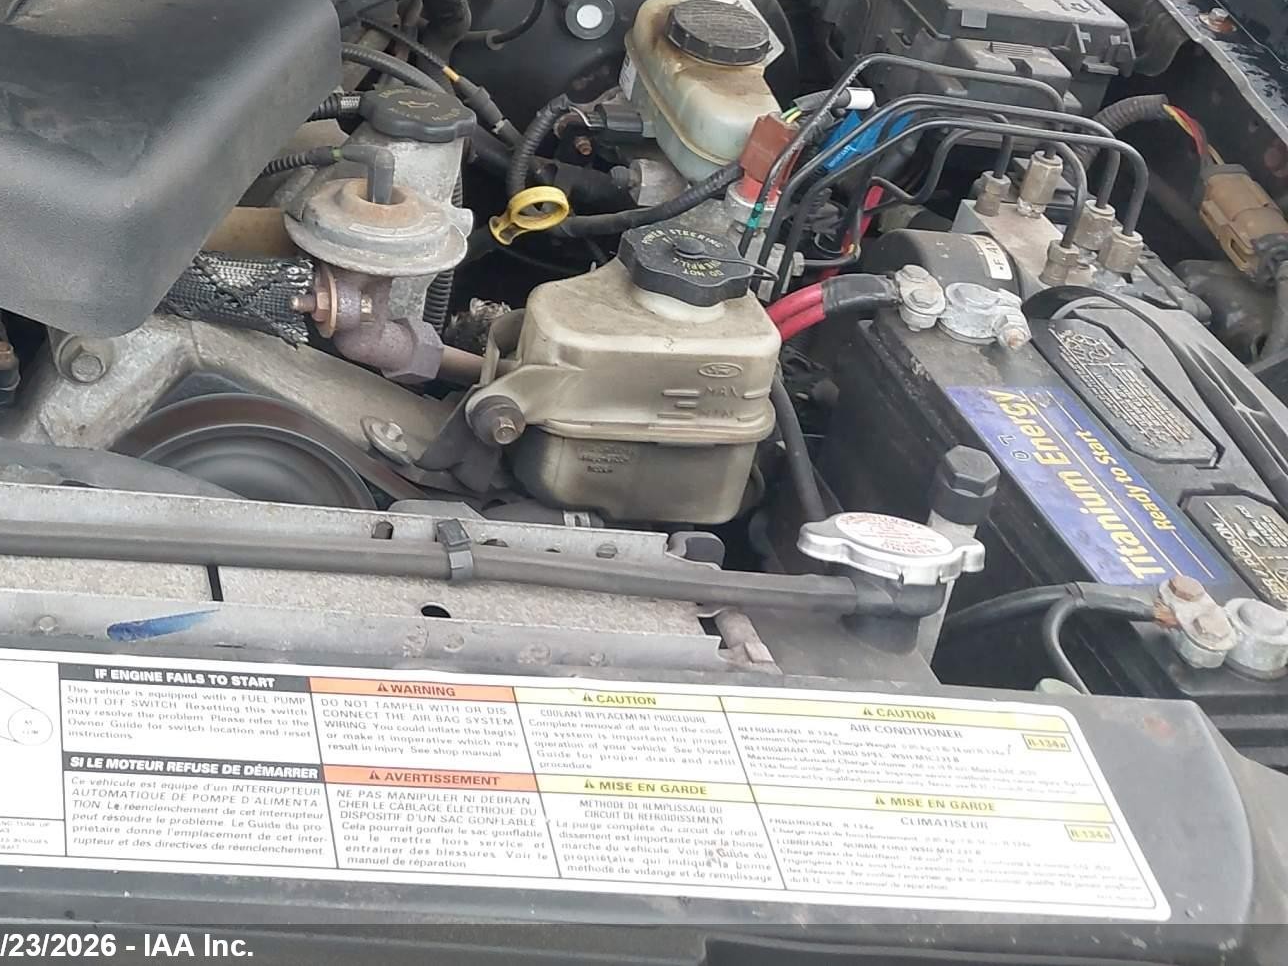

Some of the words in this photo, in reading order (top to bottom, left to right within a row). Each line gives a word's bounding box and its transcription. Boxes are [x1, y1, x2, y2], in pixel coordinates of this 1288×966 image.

[669, 228, 727, 249] STEERING
[986, 389, 1071, 466] Energy
[1073, 430, 1117, 469] Start
[1110, 467, 1133, 483] to
[1127, 482, 1176, 531] Ready
[1057, 469, 1166, 579] Titanium
[94, 668, 109, 679] IF
[110, 669, 163, 681] ENGINE
[165, 672, 206, 683] FAILS
[206, 674, 228, 685] TO
[228, 675, 276, 687] START
[67, 684, 89, 693] This
[93, 687, 130, 695] vehicle
[240, 694, 269, 703] FUEL
[273, 696, 306, 704] PUMP
[389, 684, 456, 696] WARNING
[66, 696, 98, 704] SHUT
[103, 697, 127, 705] OFF
[185, 702, 240, 713] Resetting
[244, 705, 266, 713] this
[320, 698, 338, 706] DO
[343, 699, 367, 707] NOT
[375, 701, 423, 710] TAMPER
[428, 704, 459, 712] WITH
[595, 695, 657, 704] CAUTION
[210, 714, 245, 722] Please
[322, 709, 378, 718] CONNECT
[384, 712, 405, 720] THE
[435, 715, 460, 723] BAG
[464, 717, 514, 725] SYSTEM
[875, 708, 936, 720] CAUTION
[67, 718, 104, 726] Owner
[109, 719, 143, 728] Guide
[147, 721, 162, 729] for
[167, 724, 205, 732] switch
[209, 725, 254, 734] location
[372, 722, 393, 730] You
[396, 724, 425, 732] could
[849, 723, 871, 732] AIR
[874, 726, 963, 737] CONDITIONER
[389, 736, 452, 744] inoperative
[361, 743, 371, 751] in
[410, 745, 429, 753] See
[433, 747, 458, 756] shop
[69, 756, 85, 767] SI
[86, 757, 104, 768] LE
[105, 758, 164, 770] MOTEUR
[165, 761, 219, 773] REFUSE
[221, 764, 241, 775] DE
[243, 765, 318, 778] DÉMARRER
[383, 772, 501, 784] AVERTISSEMENT
[71, 776, 86, 784] Ce
[231, 784, 320, 795] INTERRUPTEUR
[598, 781, 633, 791] MISE
[636, 783, 656, 792] EN
[659, 784, 707, 794] GARDE
[71, 788, 168, 799] AUTOMATIQUE
[169, 792, 187, 801] DE
[191, 793, 237, 803] POMPE
[336, 789, 352, 797] NE
[357, 790, 382, 798] PAS
[386, 791, 458, 801] MANIPULER
[462, 794, 475, 802] NI
[889, 797, 924, 807] MISE
[927, 799, 946, 808] EN
[949, 801, 995, 810] GARDE
[899, 817, 989, 828] CLIMATISEUR
